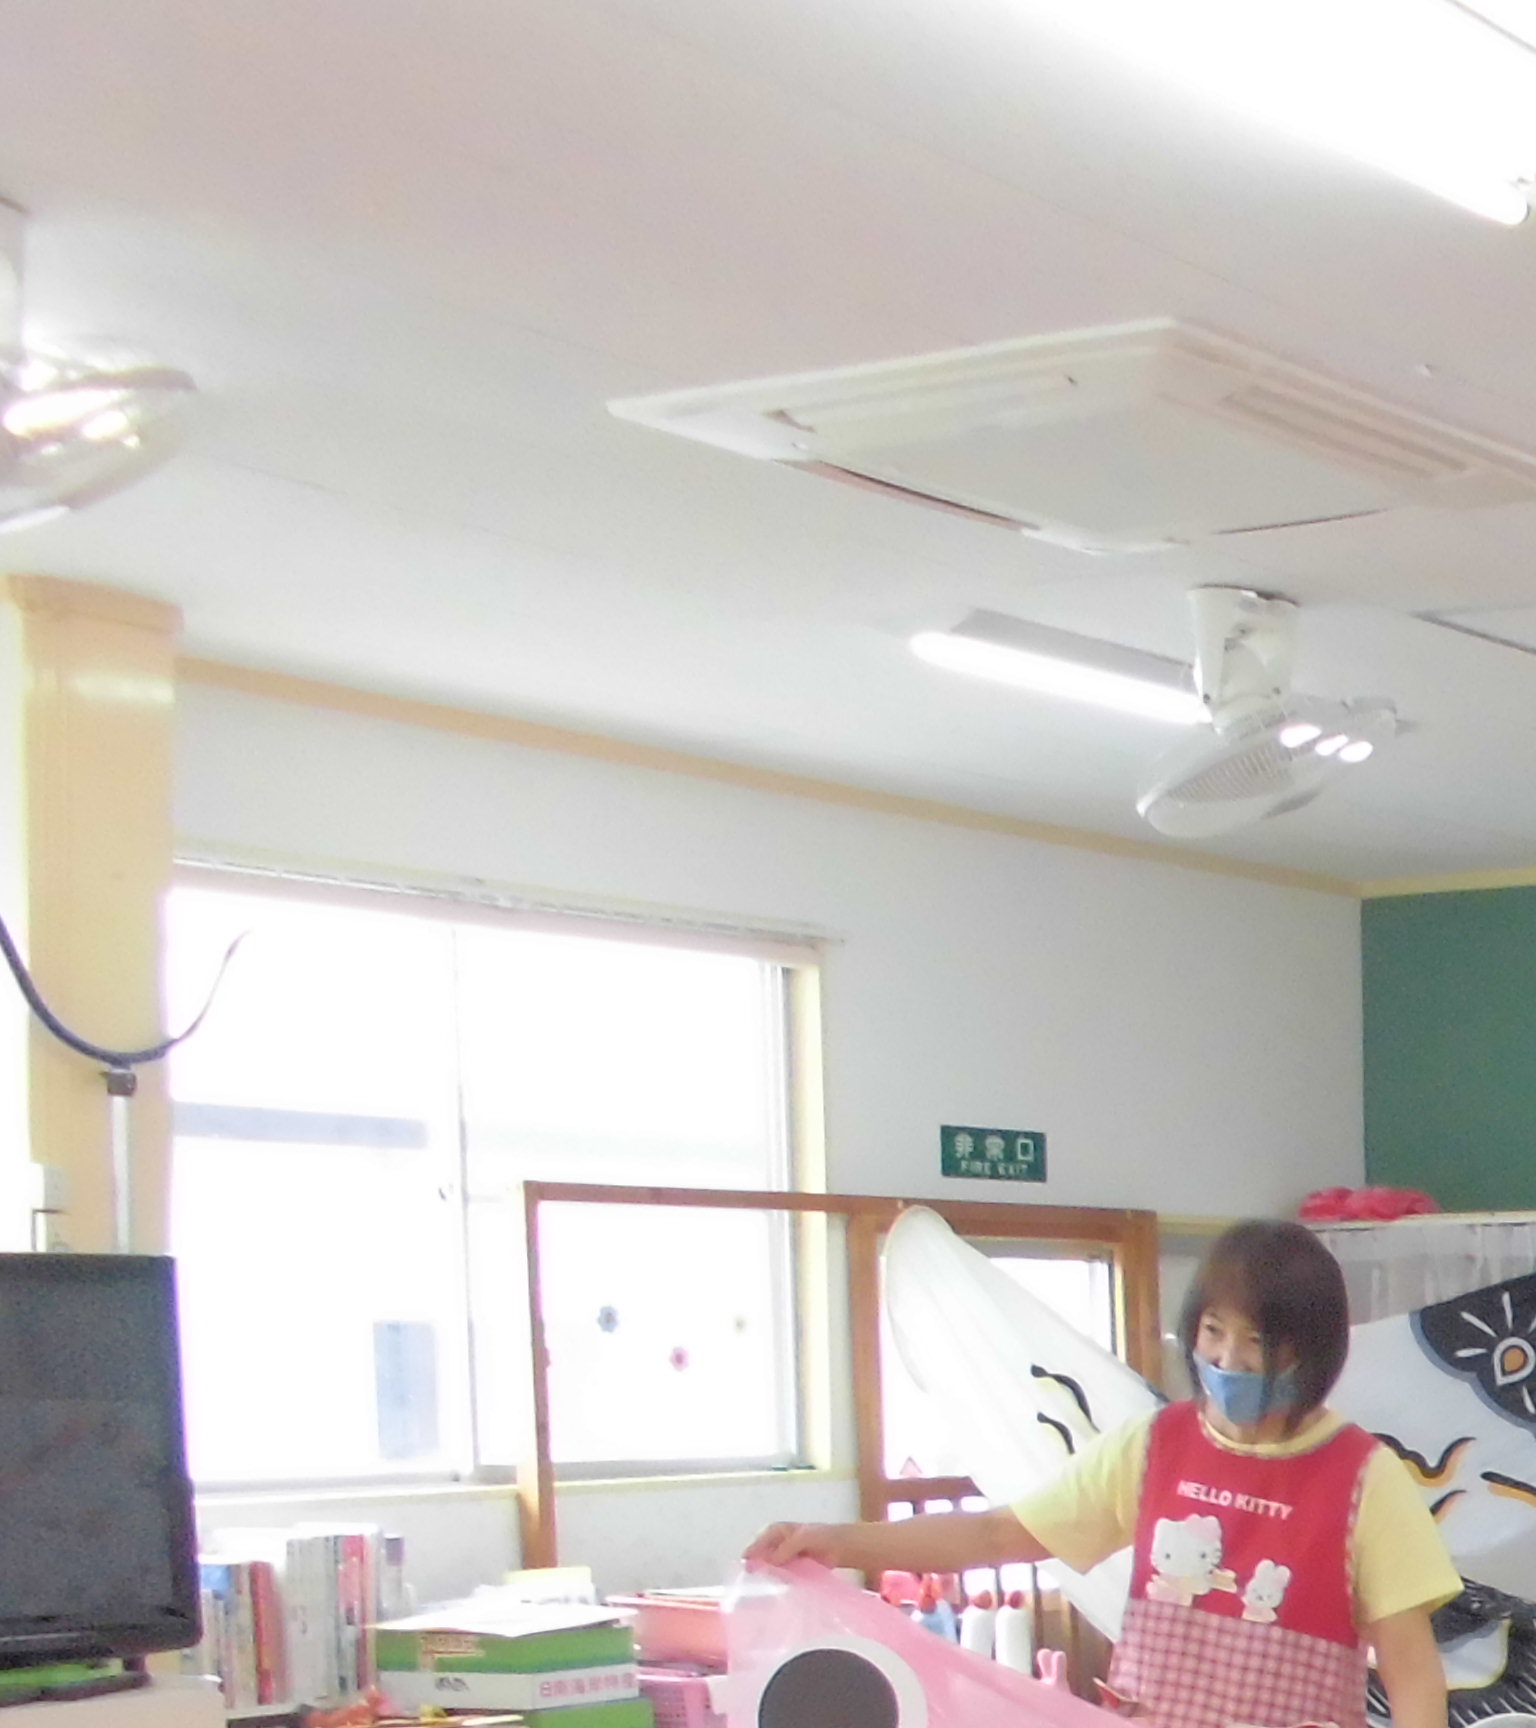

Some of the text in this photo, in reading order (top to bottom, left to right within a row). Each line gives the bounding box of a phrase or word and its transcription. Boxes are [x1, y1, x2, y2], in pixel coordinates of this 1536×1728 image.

[954, 1132, 1034, 1161] 非常口
[1176, 1480, 1294, 1520] HELLO KITTY
